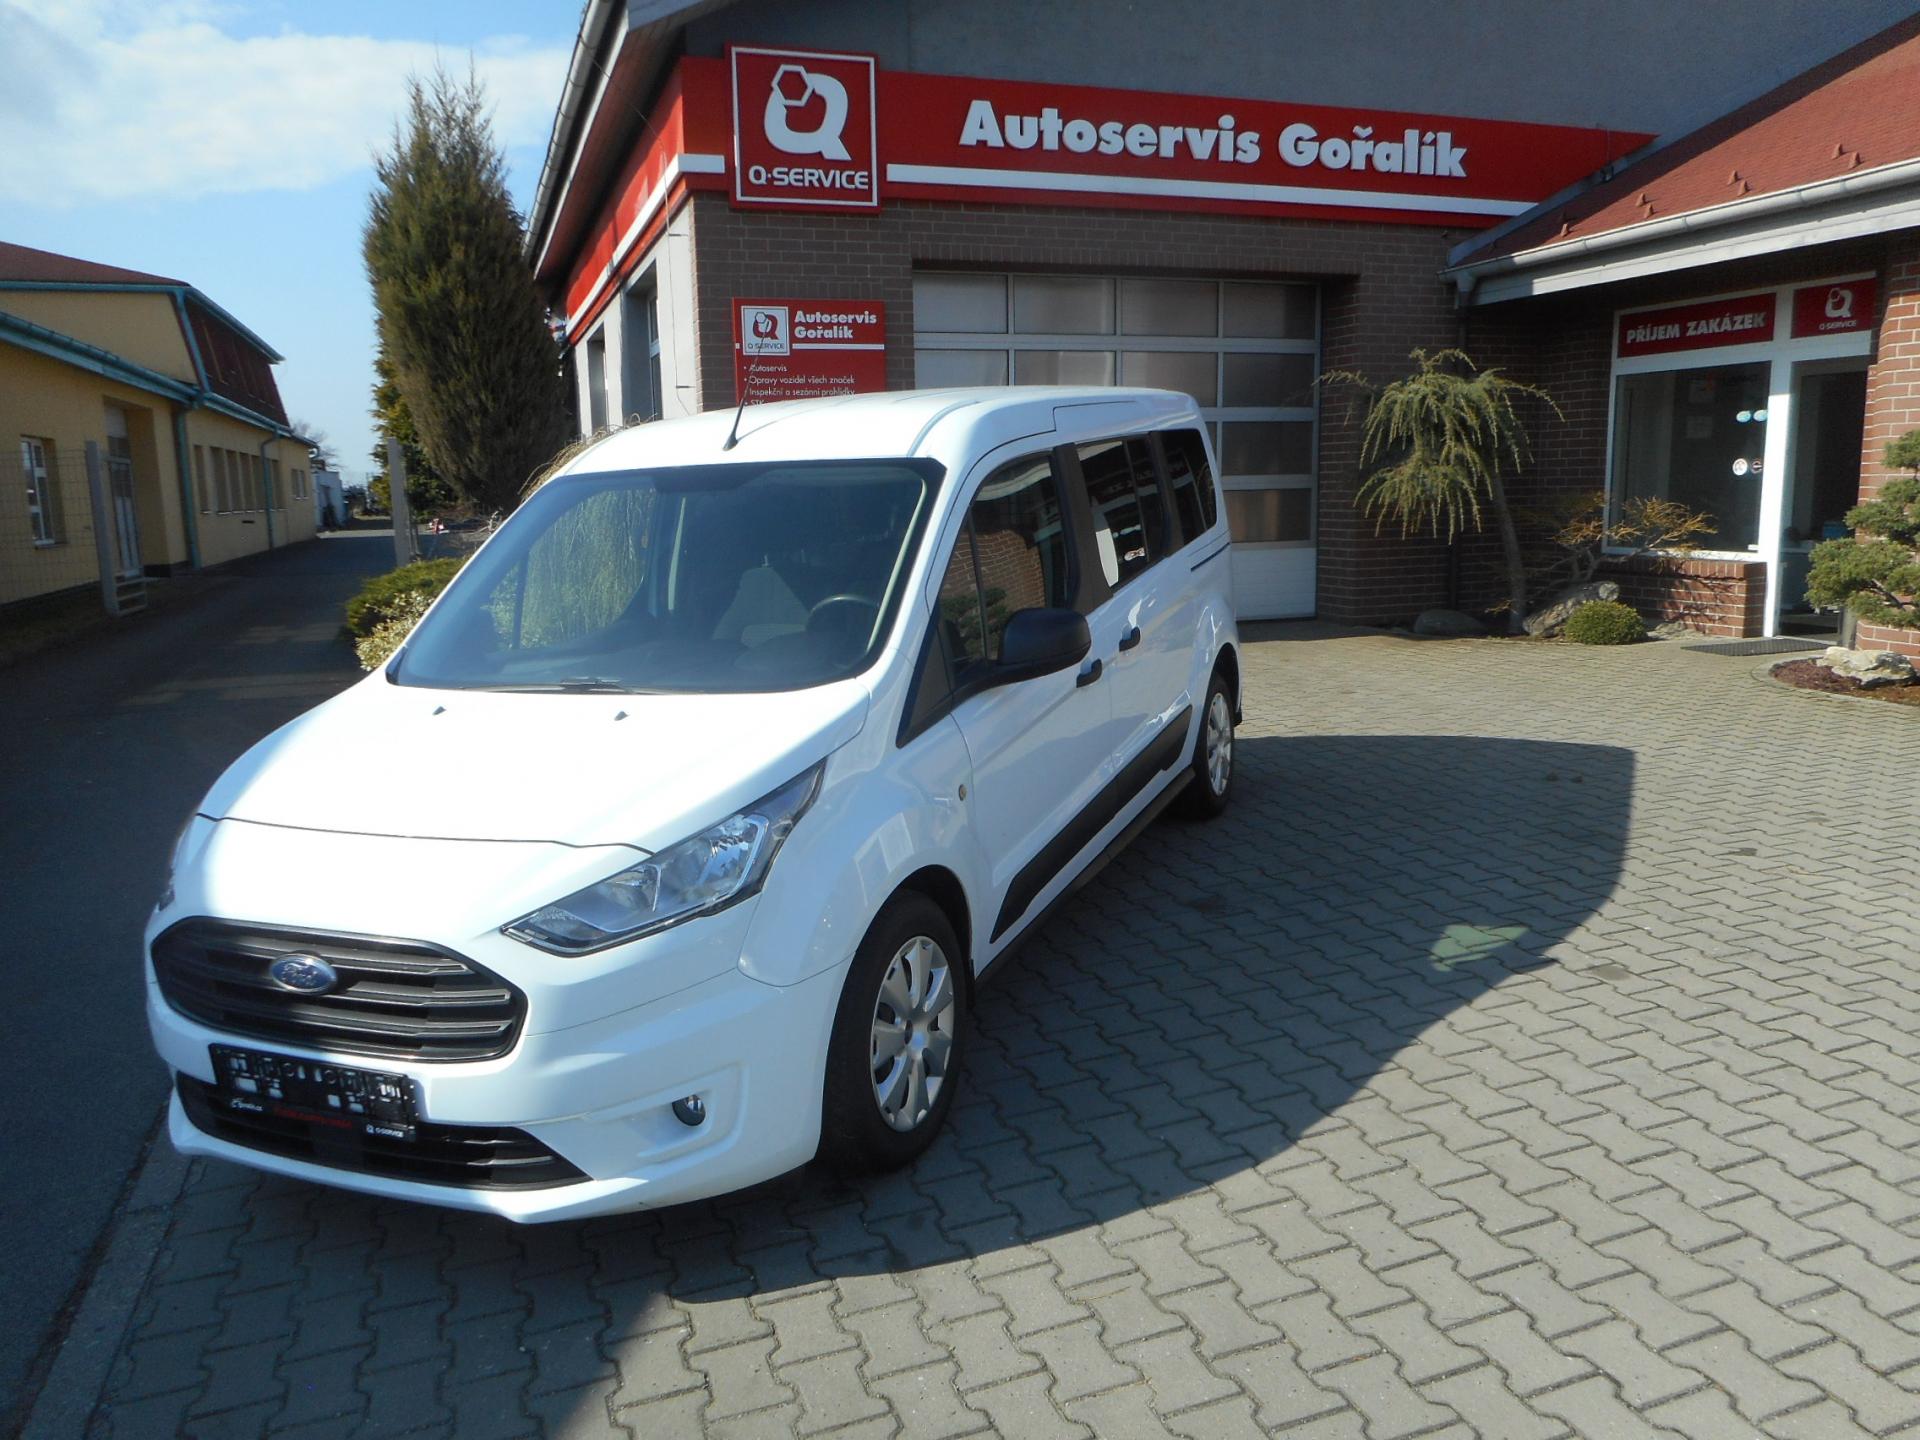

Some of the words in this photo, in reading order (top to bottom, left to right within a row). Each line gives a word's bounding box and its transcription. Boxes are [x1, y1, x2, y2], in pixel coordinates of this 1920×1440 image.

[958, 99, 1261, 164] Autoservis
[1278, 122, 1467, 178] Gořalík
[794, 310, 877, 324] Autoservis
[794, 325, 854, 339] Gořalík
[1626, 323, 1680, 343] PŘÍJEM
[1686, 312, 1767, 337] ZAKÁZEK
[749, 364, 788, 372] Autoservis
[749, 375, 778, 386] Opravy
[780, 374, 806, 384] vozidel
[808, 374, 828, 384] všech
[830, 374, 855, 384] značek
